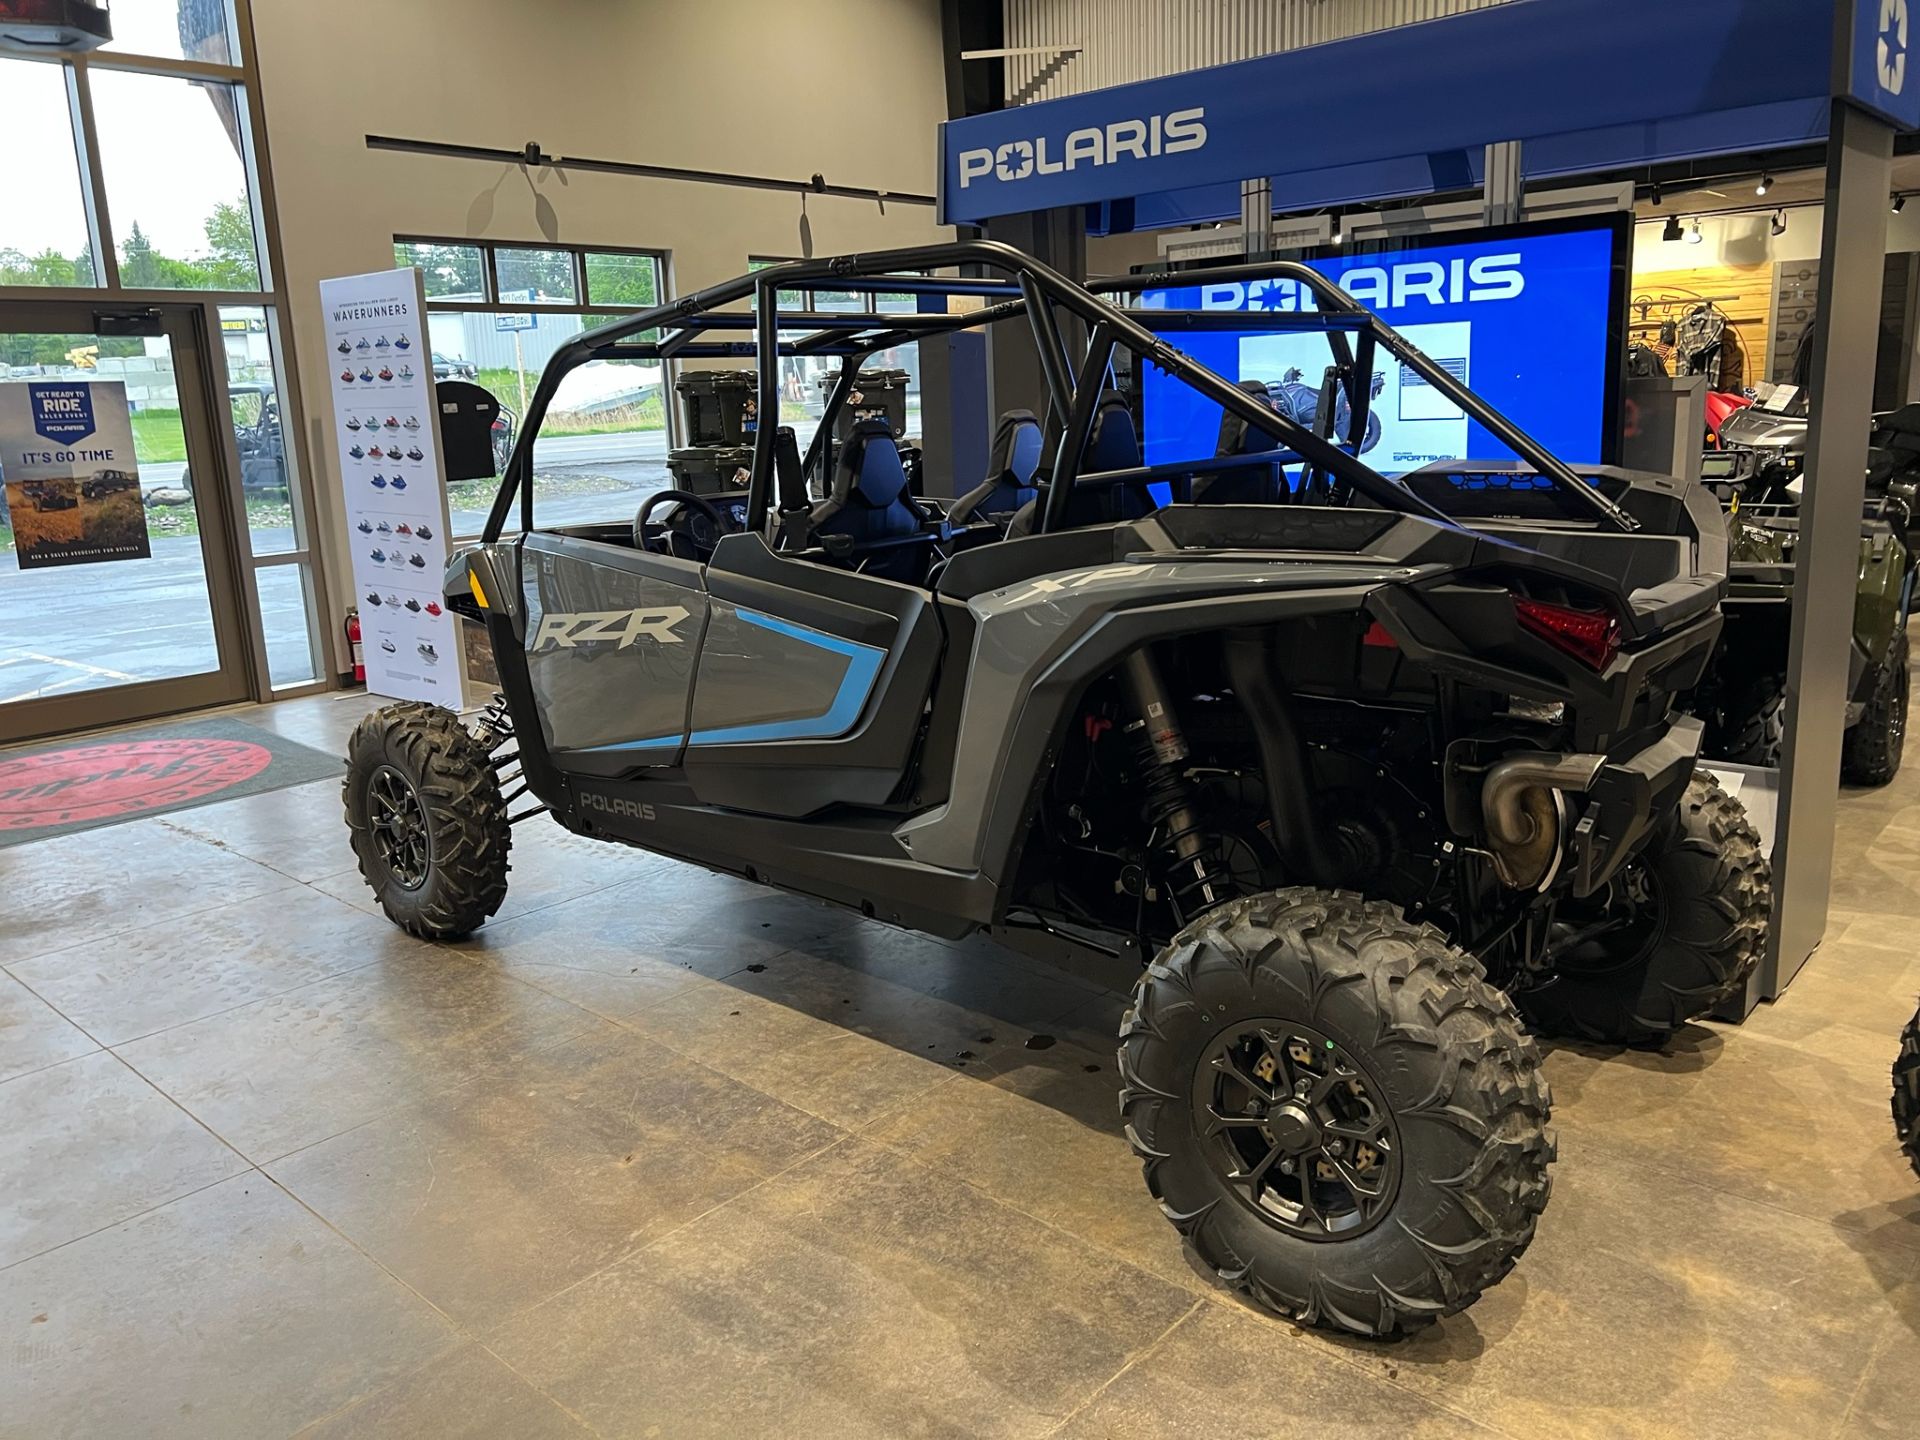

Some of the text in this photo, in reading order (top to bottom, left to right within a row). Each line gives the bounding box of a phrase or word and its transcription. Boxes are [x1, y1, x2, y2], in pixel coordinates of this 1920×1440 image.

[959, 107, 1208, 189] POLARIS
[333, 304, 407, 322] WAVERUNNERS
[35, 391, 49, 399] GET
[42, 399, 81, 413] RIDE
[22, 449, 114, 464] IT'S GO TIME
[1003, 564, 1158, 606] XP
[533, 605, 691, 652] RZR
[580, 792, 656, 821] POLARIS
